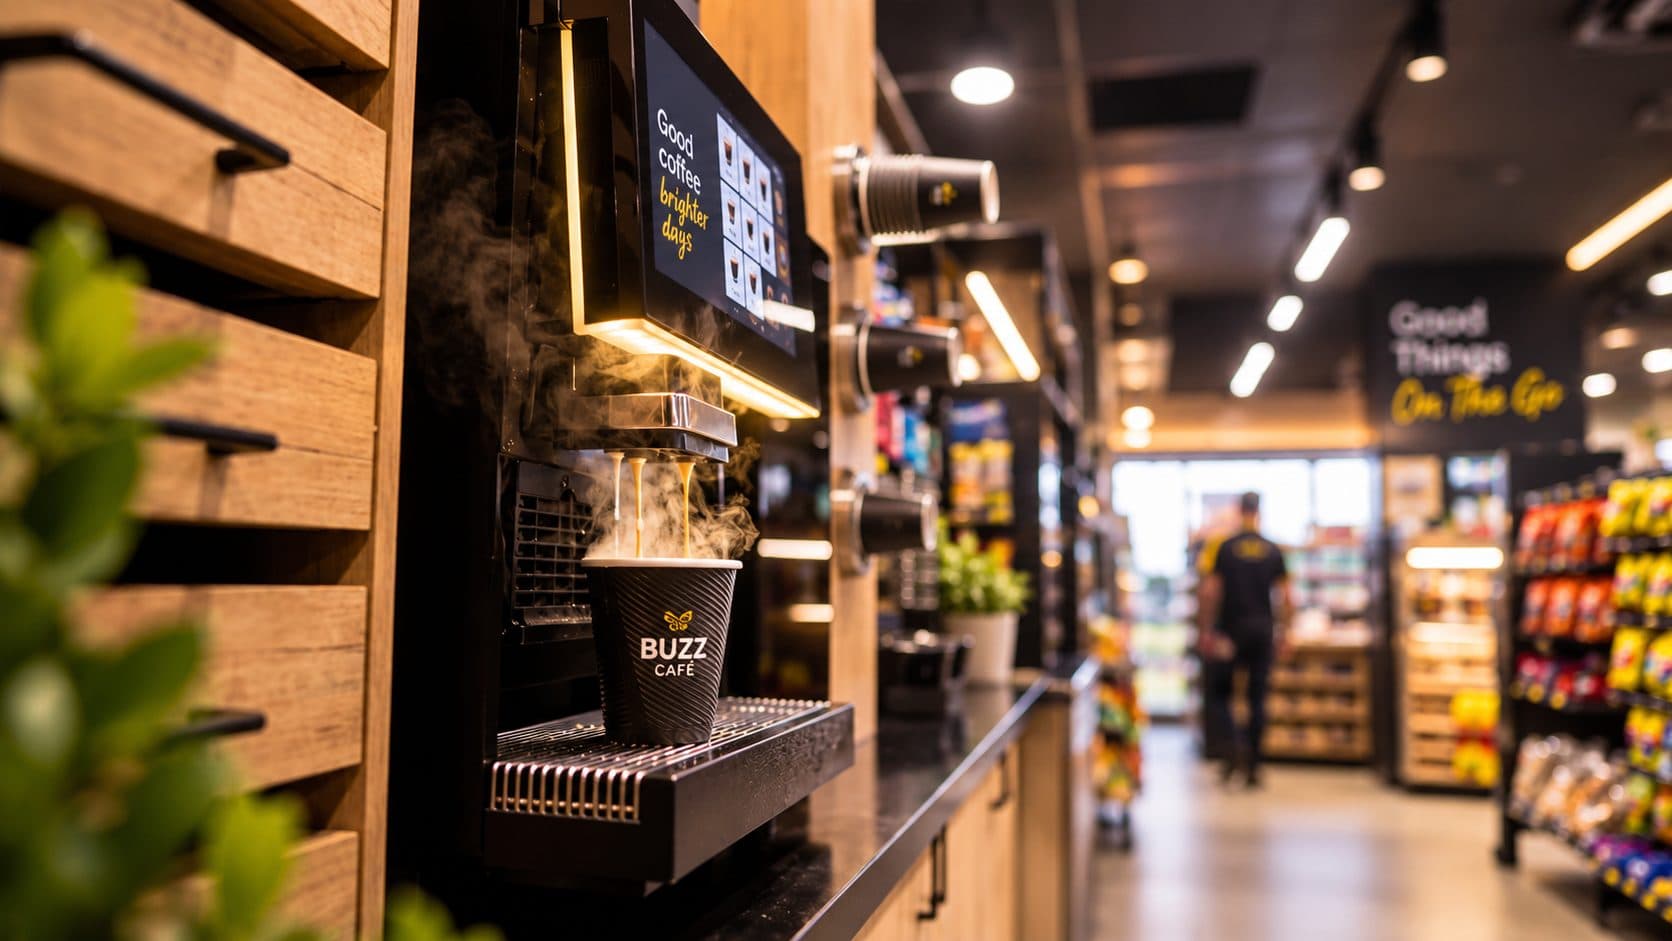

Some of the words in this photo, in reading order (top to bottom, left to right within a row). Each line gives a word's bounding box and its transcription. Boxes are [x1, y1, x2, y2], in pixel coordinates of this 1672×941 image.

[657, 109, 694, 159] Good
[658, 148, 701, 195] coffee
[659, 175, 710, 231] brighter
[662, 214, 693, 261] days
[1389, 298, 1488, 337] Good
[1390, 340, 1510, 380] Things
[1391, 378, 1443, 425] On
[1446, 374, 1507, 422] The
[1511, 367, 1564, 421] Go
[640, 637, 708, 660] BUZZ
[654, 660, 695, 677] CAFÉ
